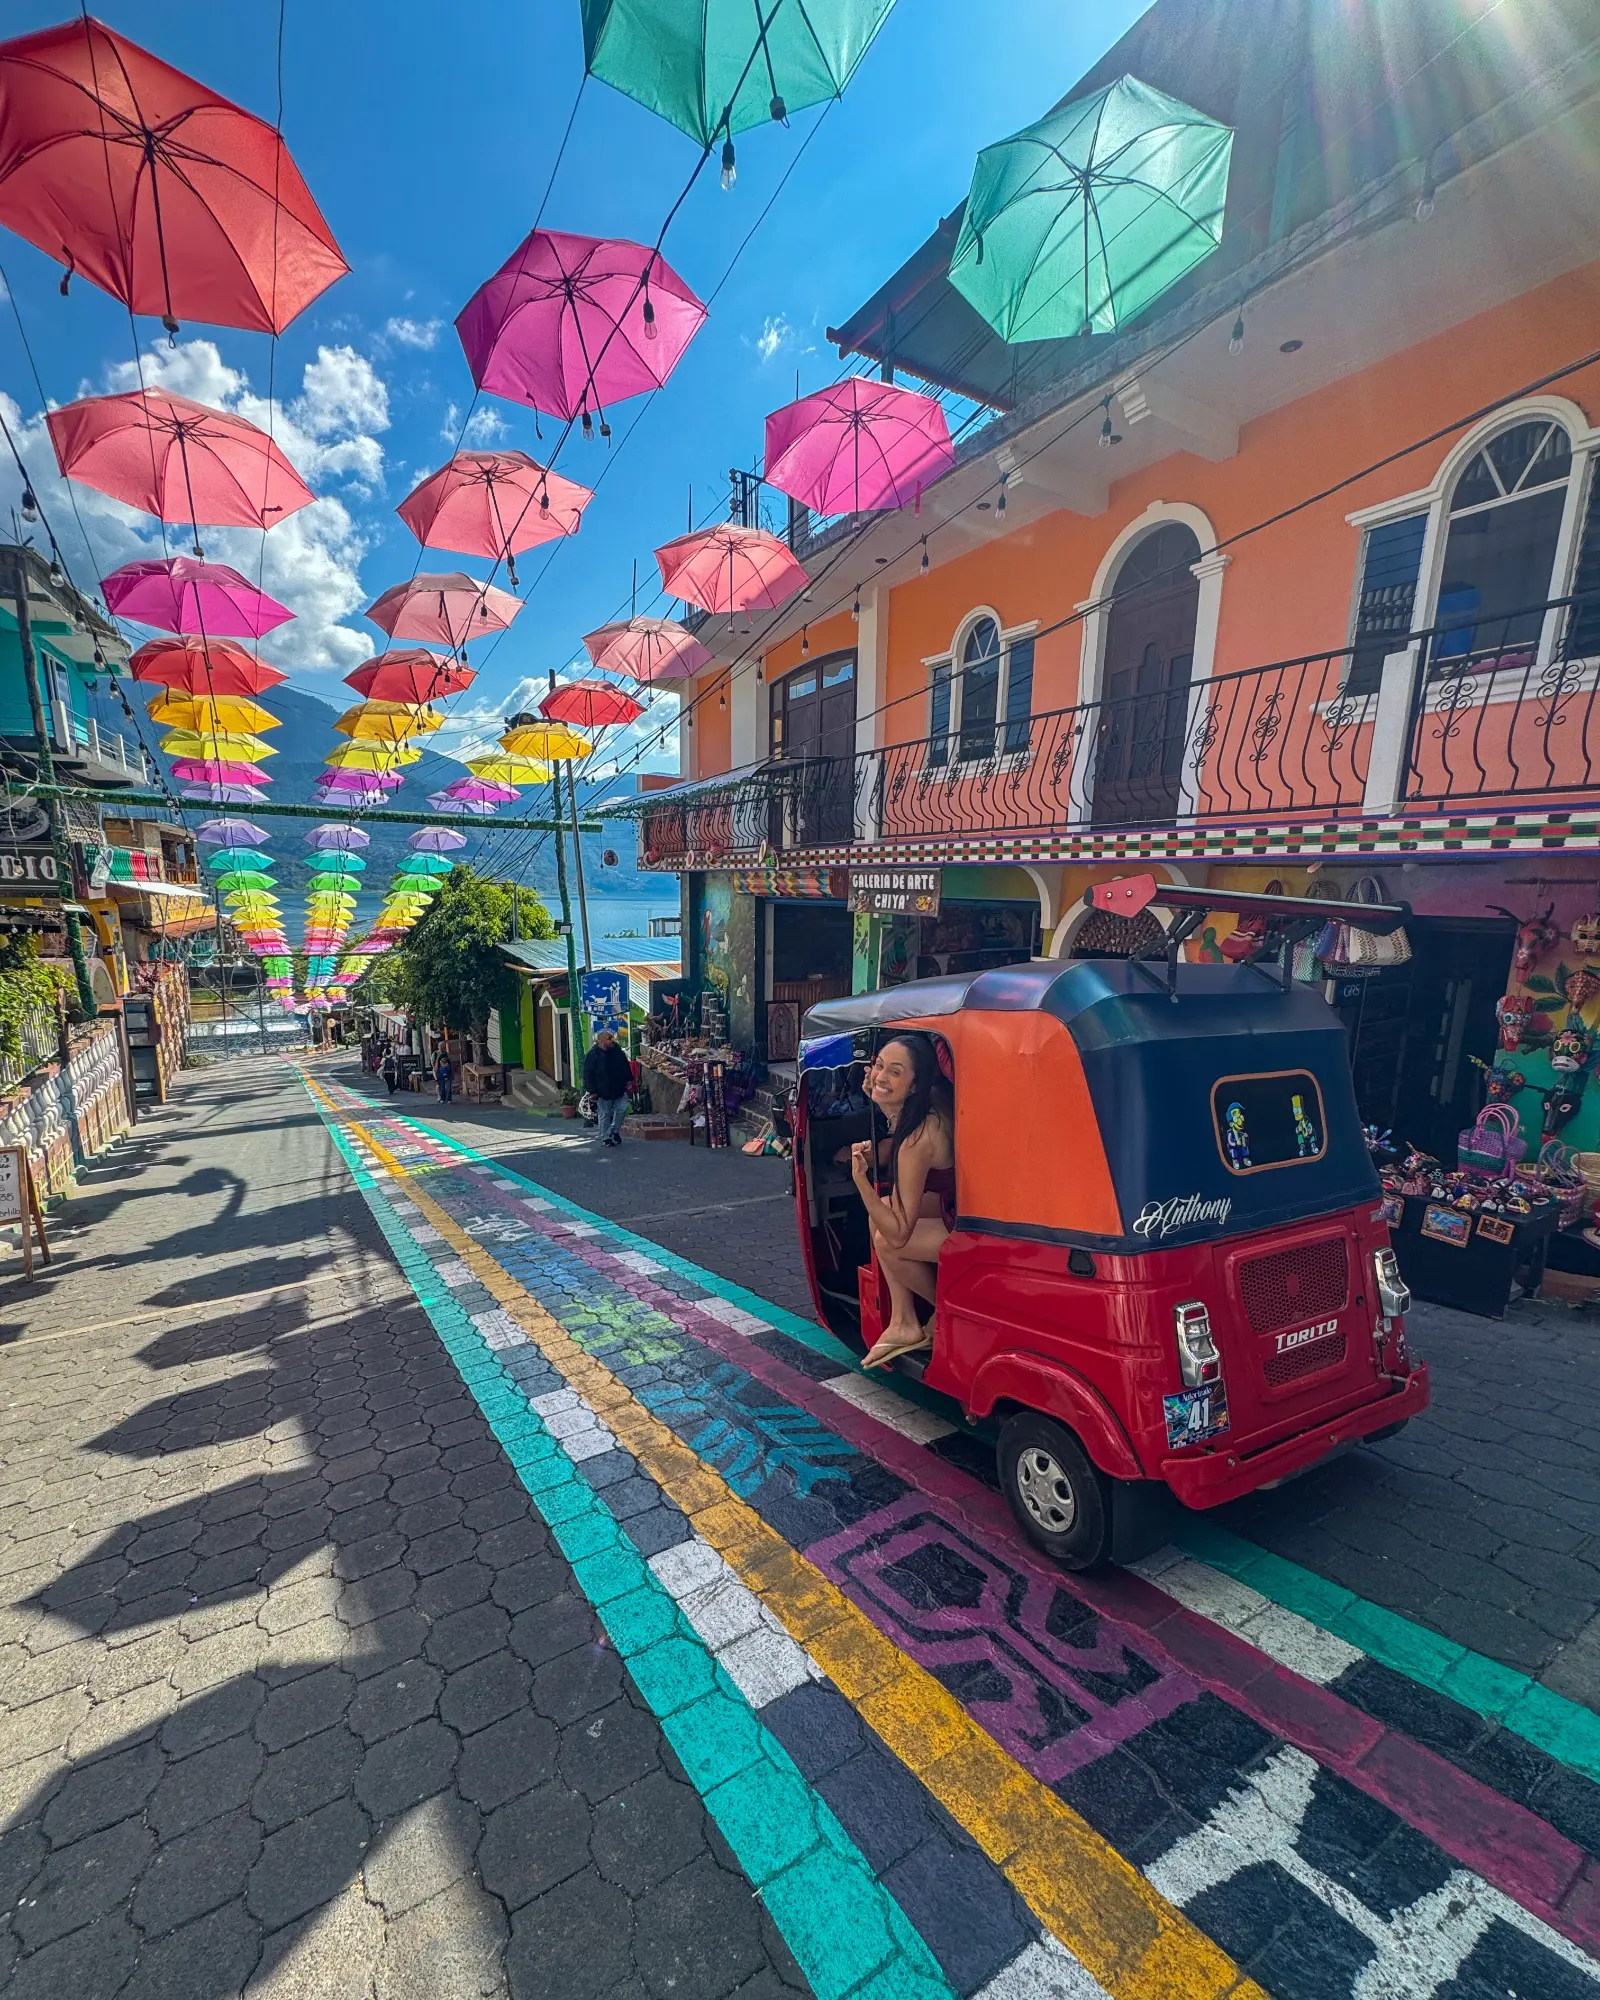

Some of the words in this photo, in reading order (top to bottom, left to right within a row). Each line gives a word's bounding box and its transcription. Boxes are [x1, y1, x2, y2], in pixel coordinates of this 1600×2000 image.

[852, 874, 891, 889] GALERIA
[892, 874, 905, 890] DE
[907, 874, 935, 890] ARTE
[1132, 1191, 1232, 1240] Anthony
[1188, 1397, 1210, 1431] 41
